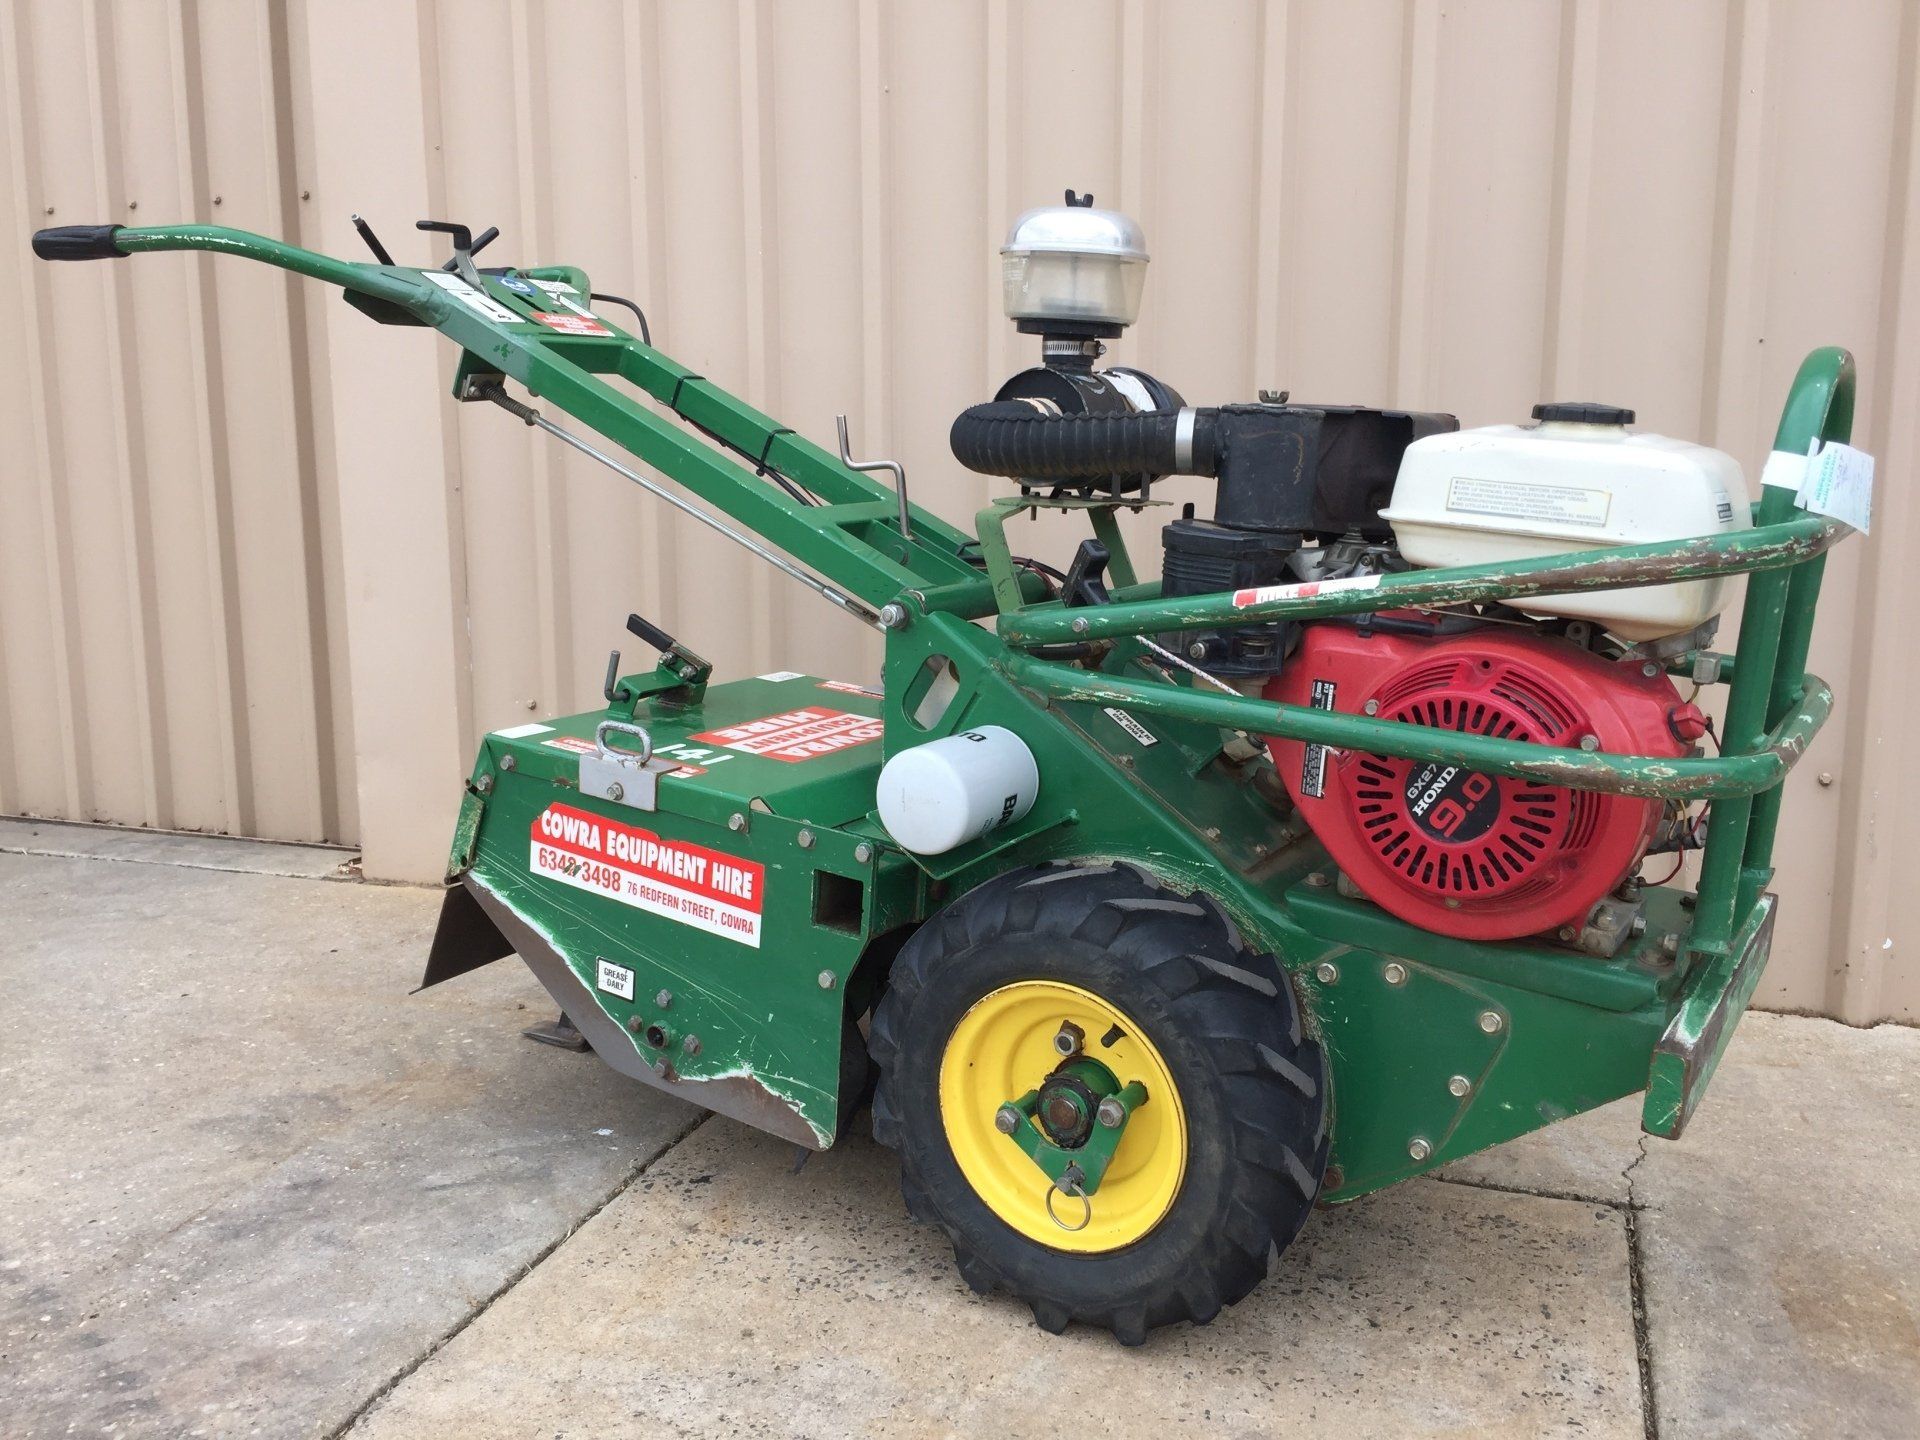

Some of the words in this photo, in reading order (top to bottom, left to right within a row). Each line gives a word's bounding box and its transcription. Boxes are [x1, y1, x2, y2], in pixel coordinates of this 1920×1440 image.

[712, 711, 826, 740] HIRE
[742, 717, 862, 750] EQUIPMENT
[1125, 723, 1144, 738] ONLY
[1412, 766, 1459, 816] HOND
[541, 809, 601, 852] COWRA
[606, 829, 707, 885] EQUIPMENT
[711, 861, 755, 900] HIRE
[627, 881, 638, 896] 76
[640, 885, 679, 910] REDFERN
[681, 899, 718, 925] STREET,
[720, 912, 754, 935] COWRA
[603, 967, 628, 983] GREASE
[606, 978, 625, 991] DAILY
